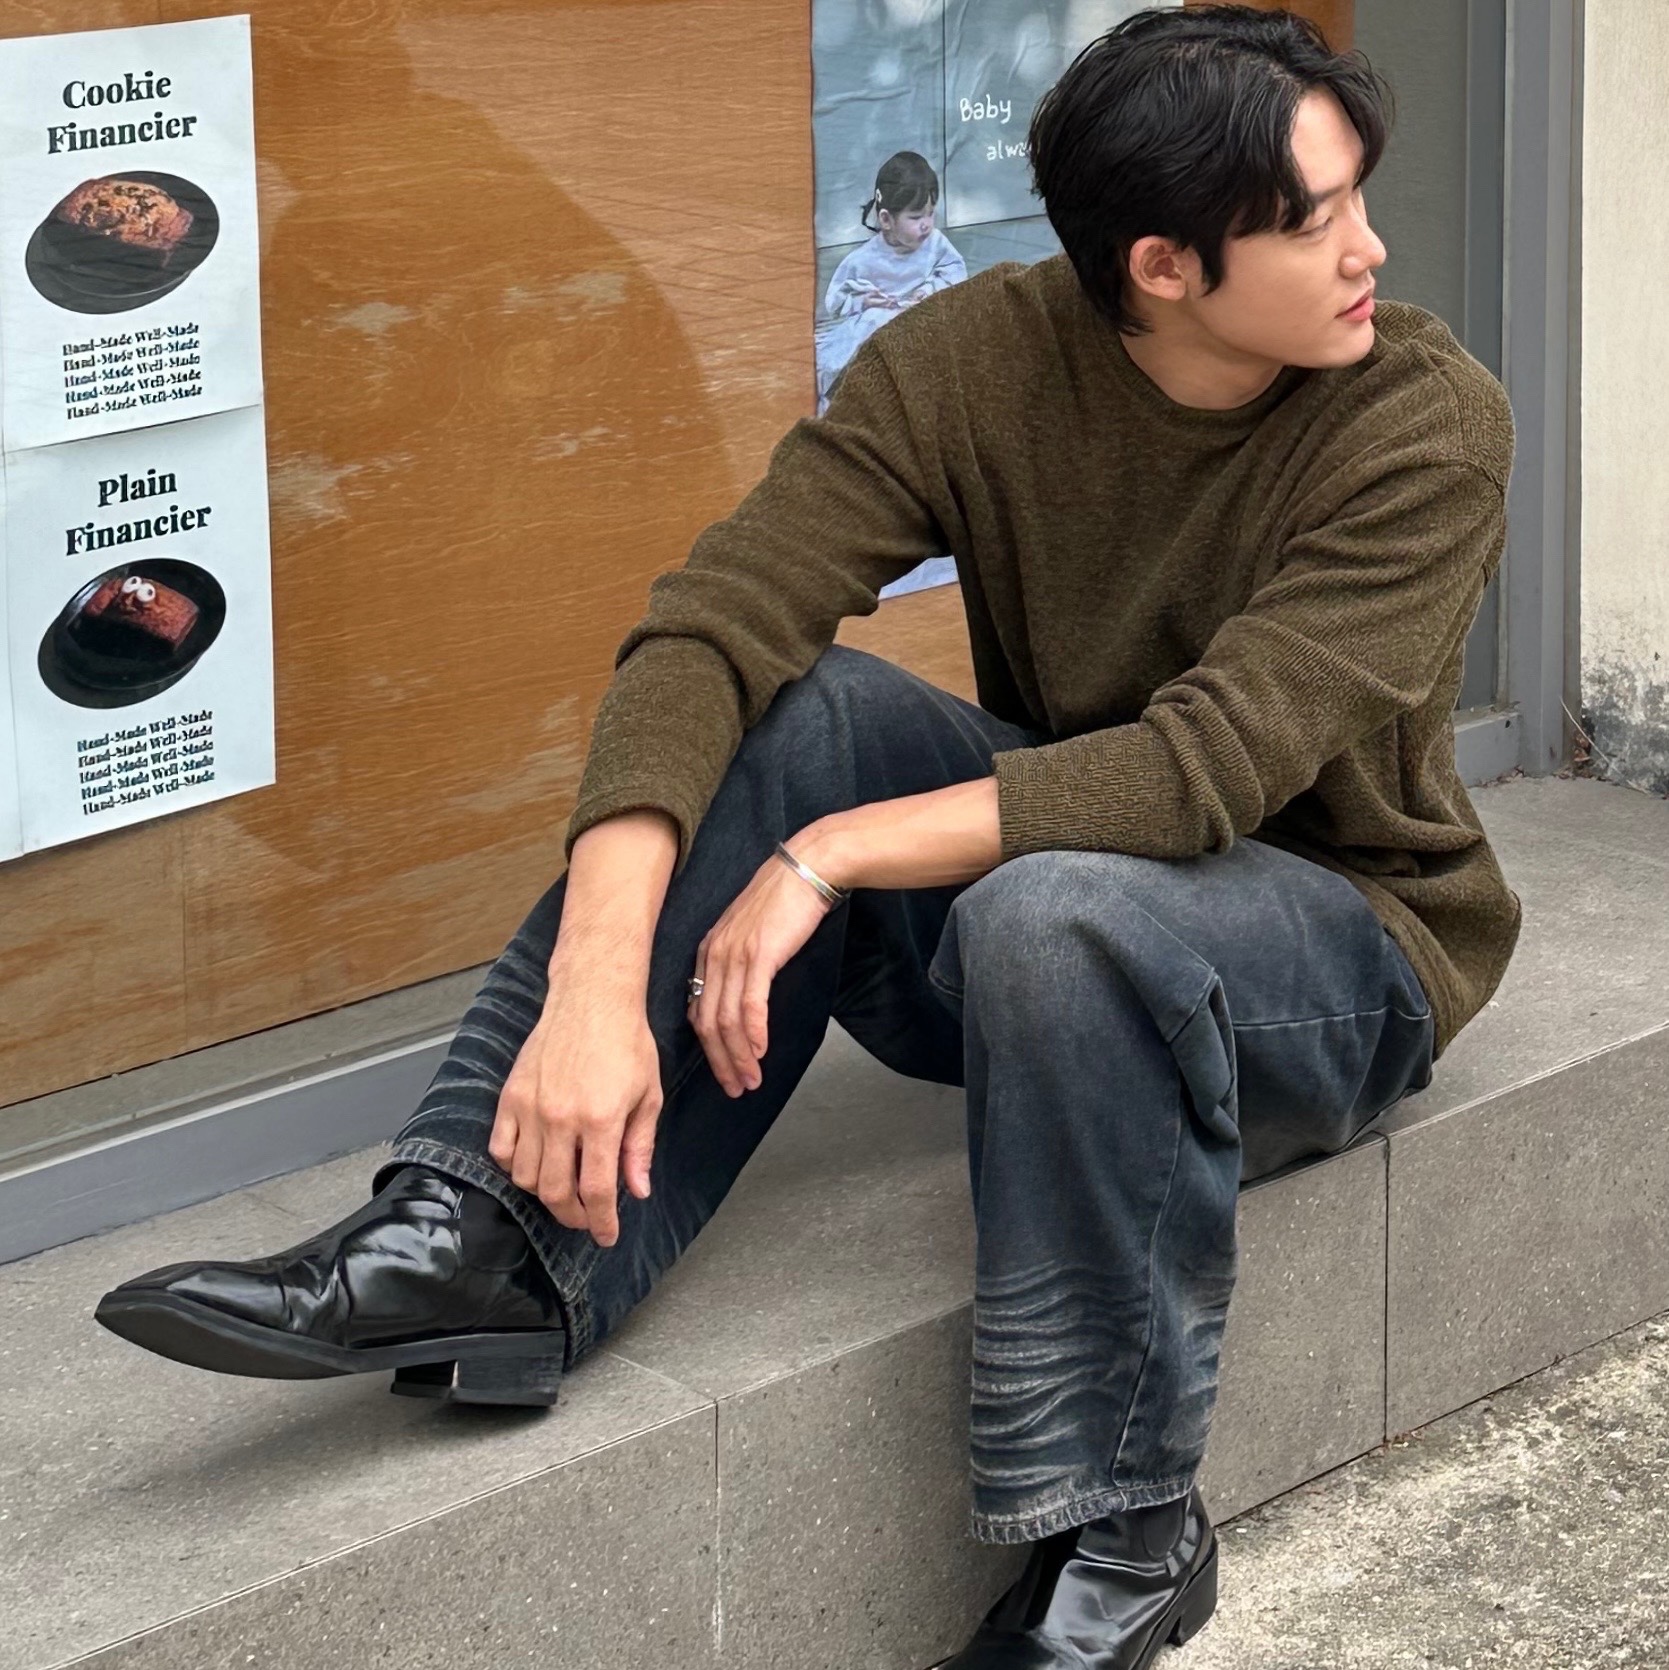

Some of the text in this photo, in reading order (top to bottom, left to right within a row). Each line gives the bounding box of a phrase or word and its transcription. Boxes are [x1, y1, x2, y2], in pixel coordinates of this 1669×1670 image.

[62, 70, 171, 109] Cookie
[960, 94, 1011, 124] Baby
[47, 111, 197, 155] Financier
[97, 468, 177, 508] Plain
[66, 504, 212, 556] Financier
